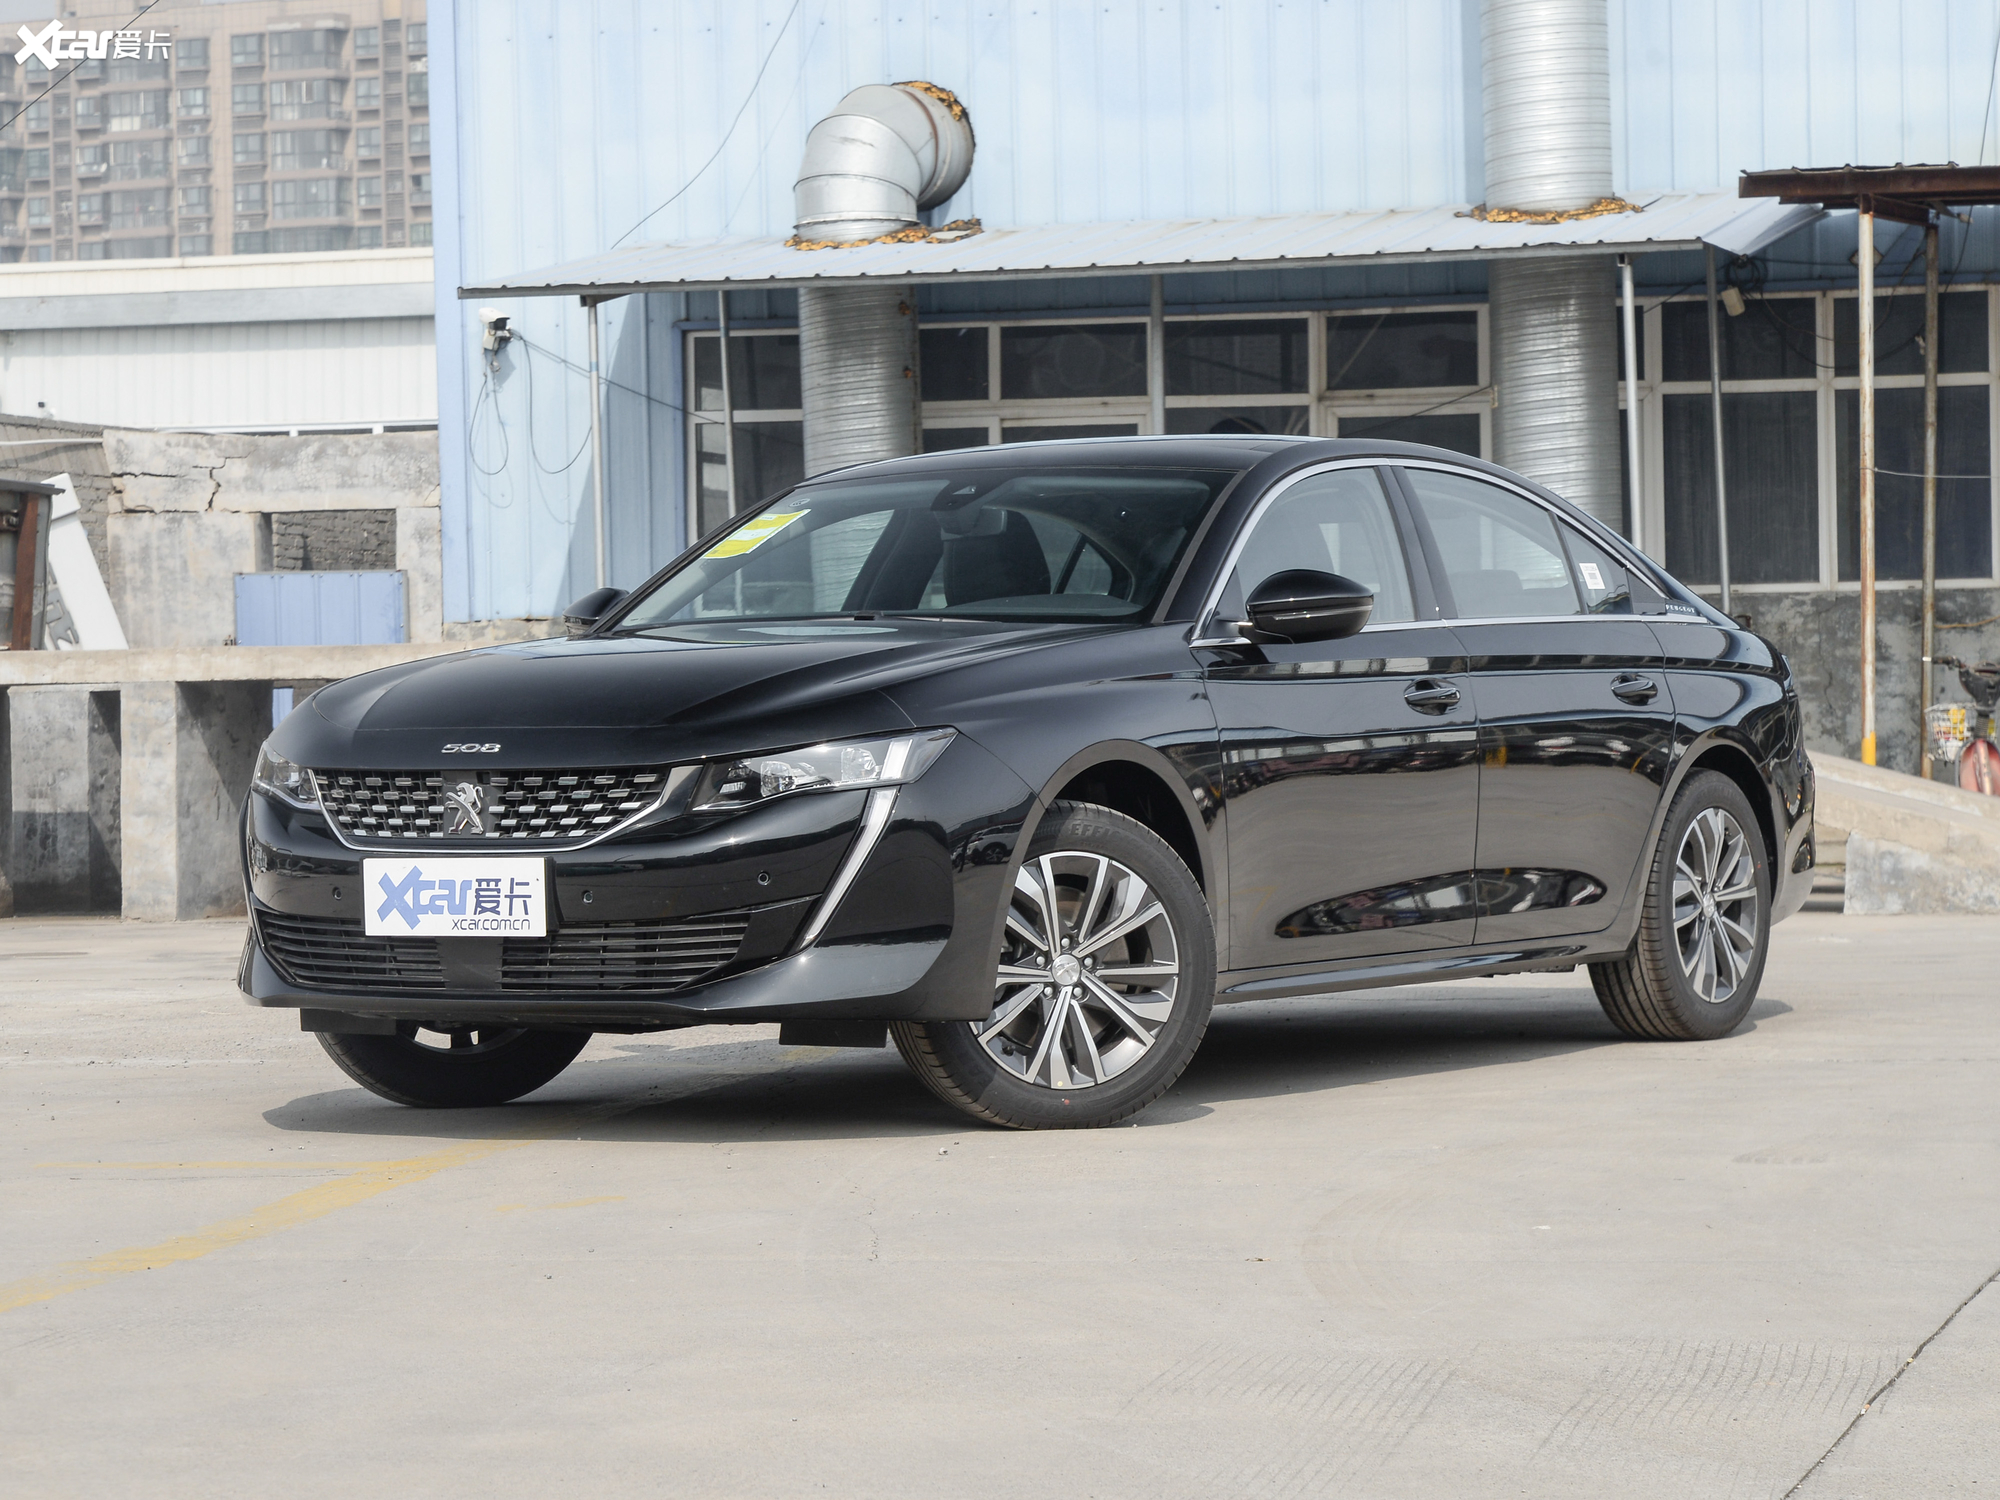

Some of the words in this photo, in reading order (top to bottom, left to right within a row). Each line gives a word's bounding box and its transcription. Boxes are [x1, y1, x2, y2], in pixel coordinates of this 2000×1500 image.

[441, 743, 501, 753] 508
[474, 877, 532, 916] 爱卡
[451, 918, 531, 931] xcar.com.cn
